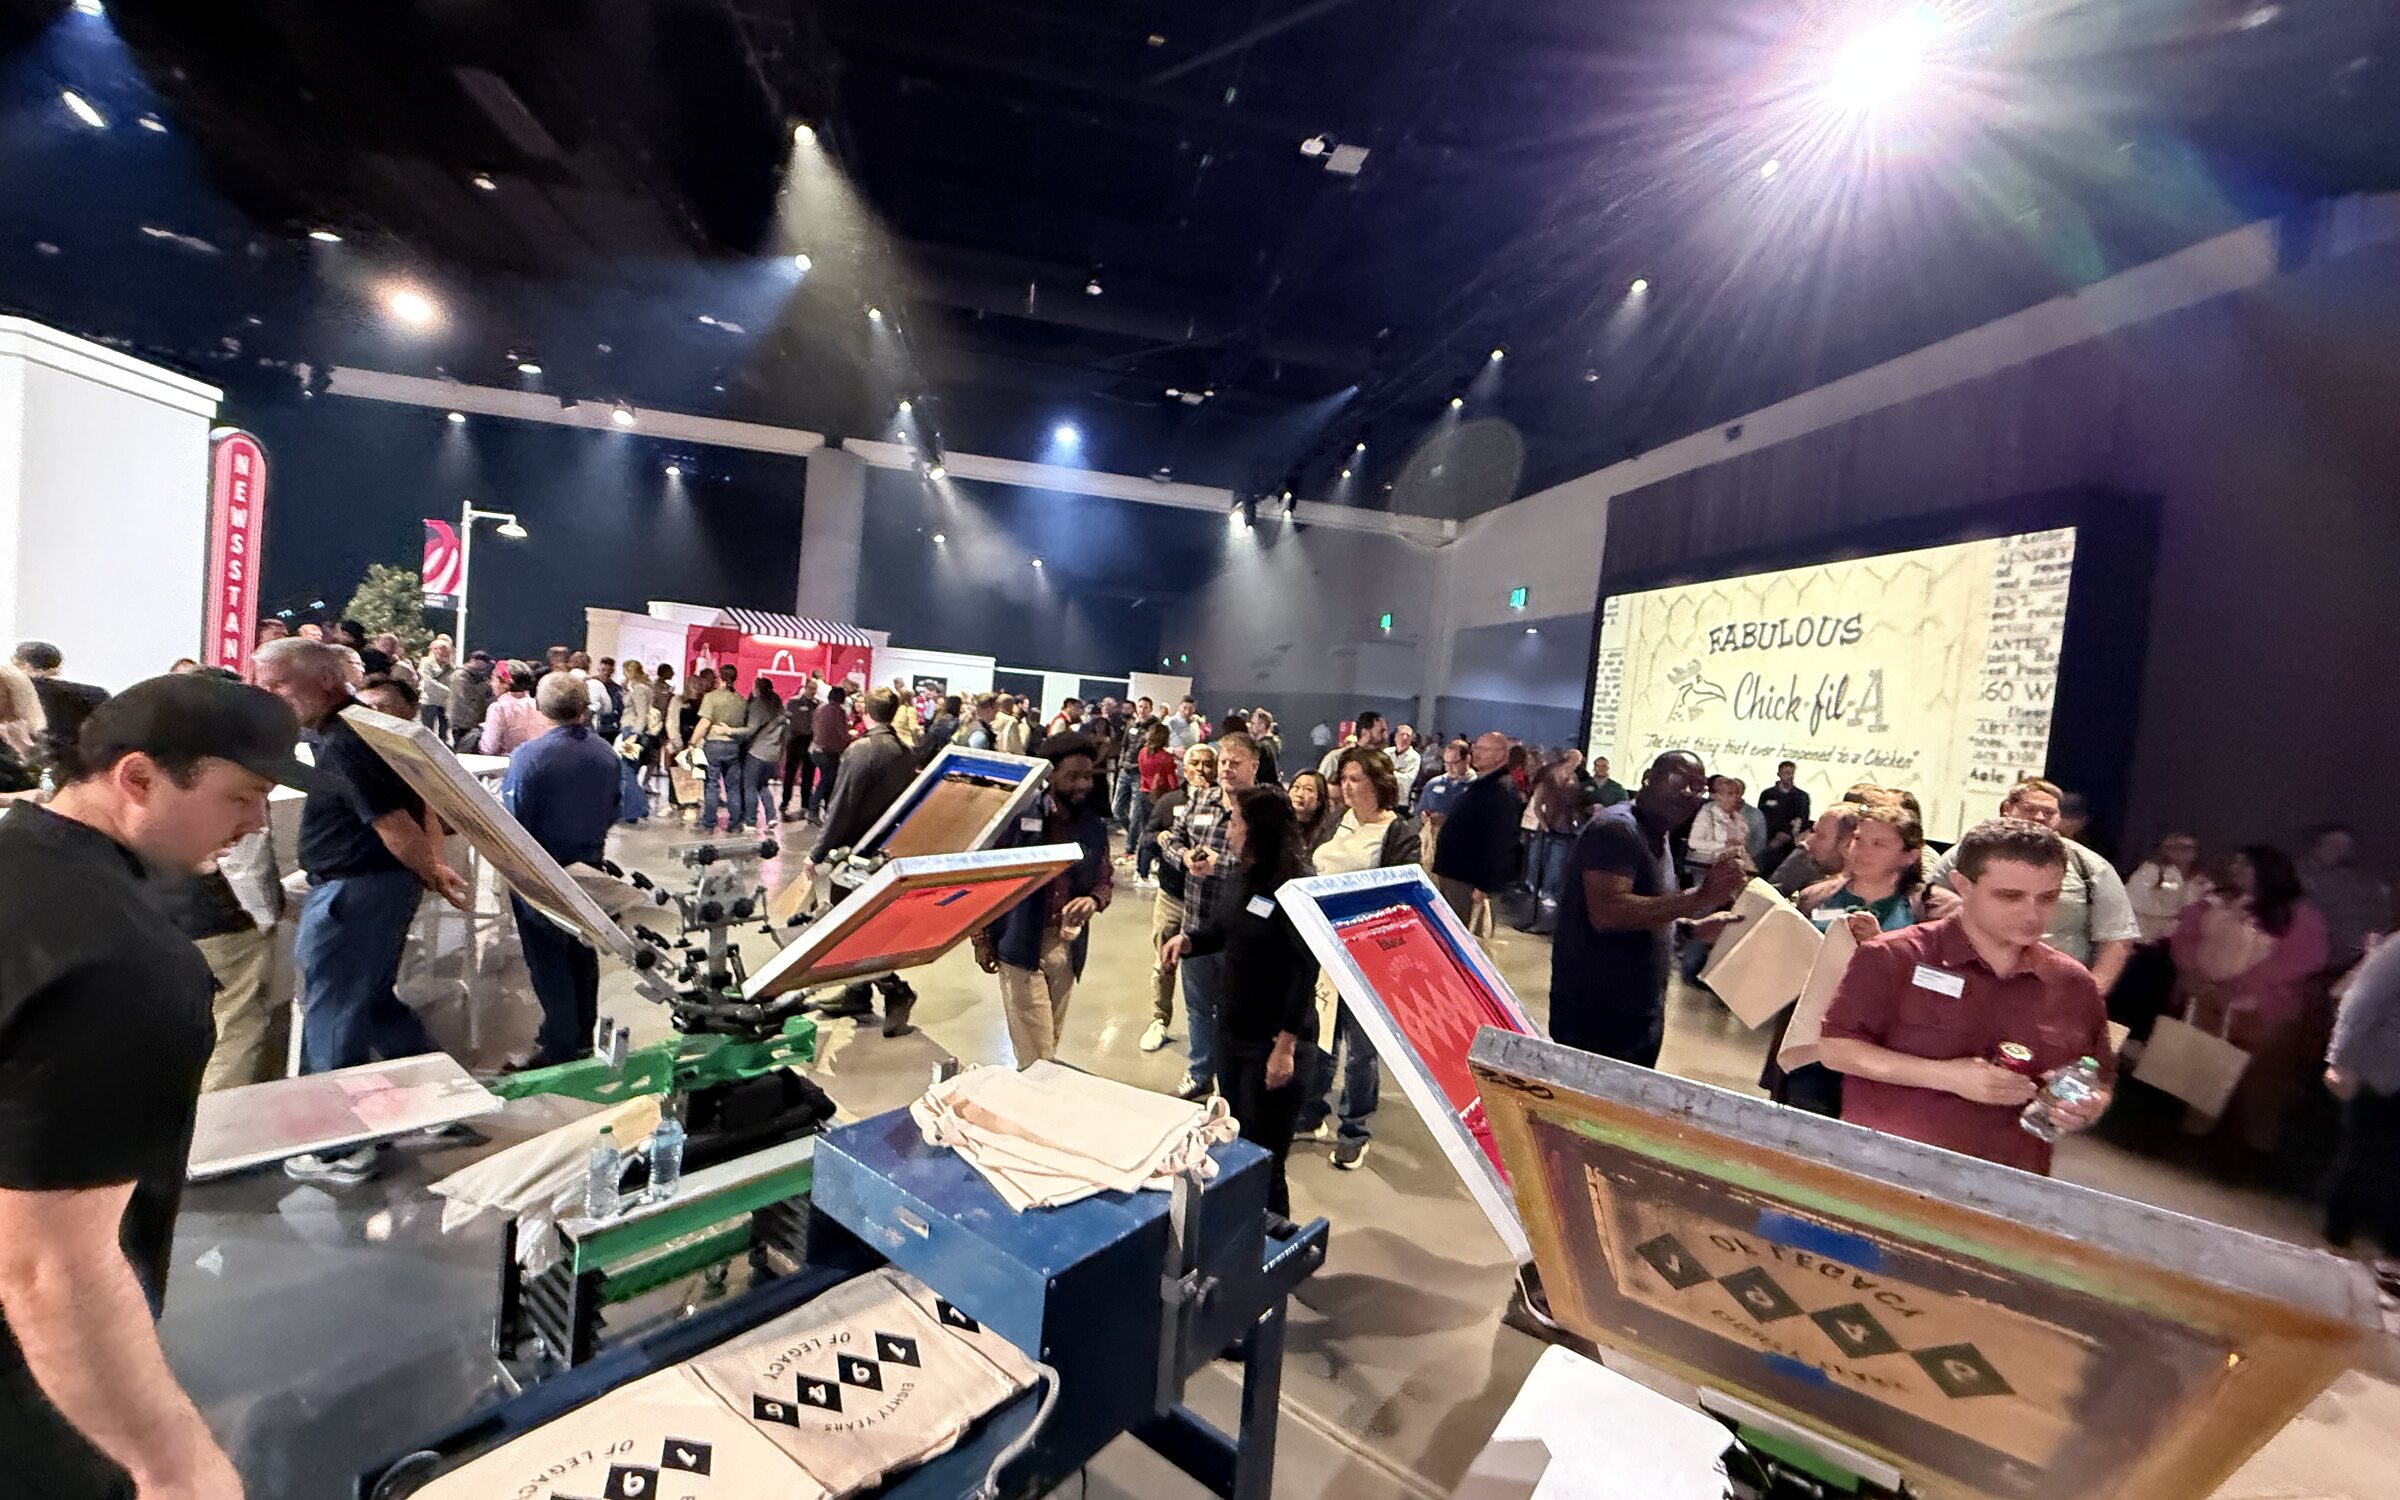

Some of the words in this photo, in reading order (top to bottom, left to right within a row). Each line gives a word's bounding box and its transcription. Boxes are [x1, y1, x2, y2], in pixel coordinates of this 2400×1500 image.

[1709, 612, 1864, 655] FABULOUS
[828, 1332, 851, 1346] OF
[763, 1337, 822, 1381] LEGACY
[878, 1382, 915, 1421] EIGHTY
[824, 1416, 878, 1432] YEARS
[604, 1438, 634, 1458] OF
